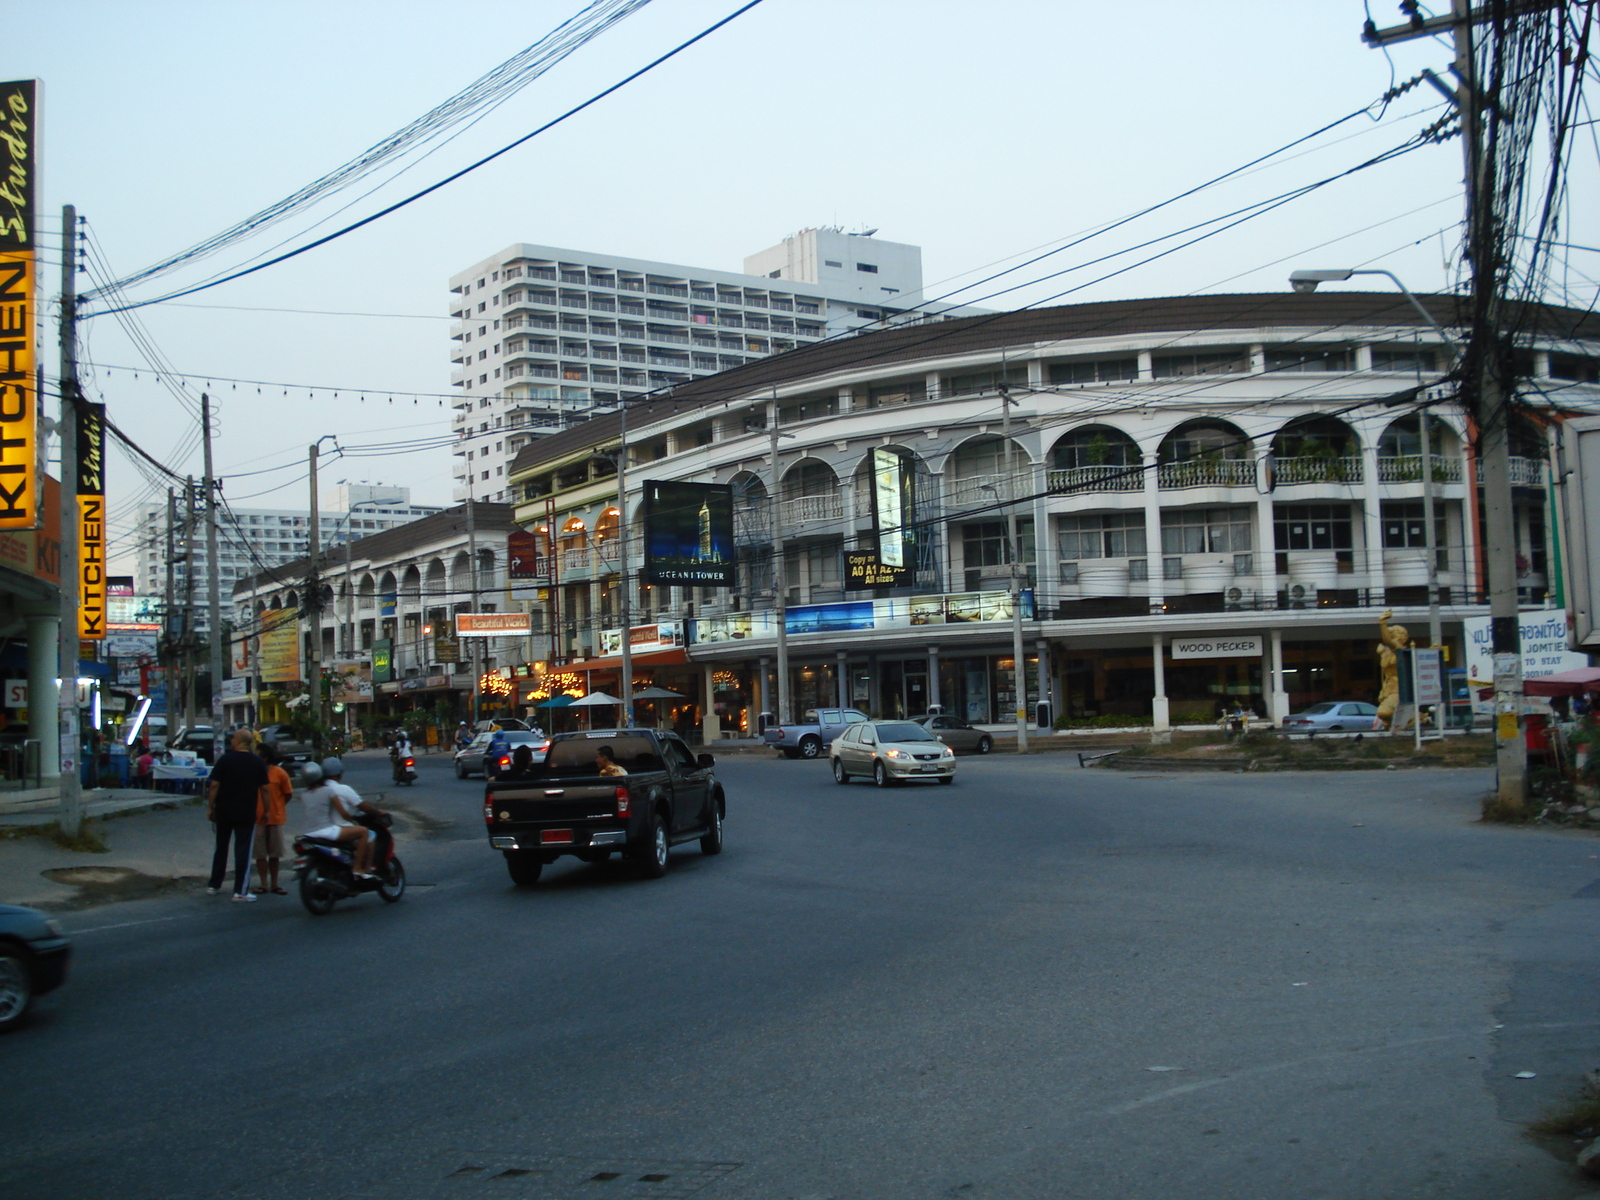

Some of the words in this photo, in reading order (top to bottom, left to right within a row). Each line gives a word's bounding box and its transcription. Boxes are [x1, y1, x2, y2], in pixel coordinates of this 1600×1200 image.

[0, 261, 26, 519] KITCHEN
[848, 555, 867, 566] Copy
[84, 501, 101, 635] KITCHEN
[865, 564, 877, 576] A1
[696, 572, 724, 580] TOWER
[865, 575, 875, 585] All
[876, 575, 895, 584] sizes
[472, 618, 503, 629] Beautiful
[505, 617, 527, 627] World
[1179, 643, 1213, 653] WOOD
[1216, 641, 1255, 652] PECKER
[1525, 658, 1536, 666] TO
[1541, 656, 1562, 665] STAY
